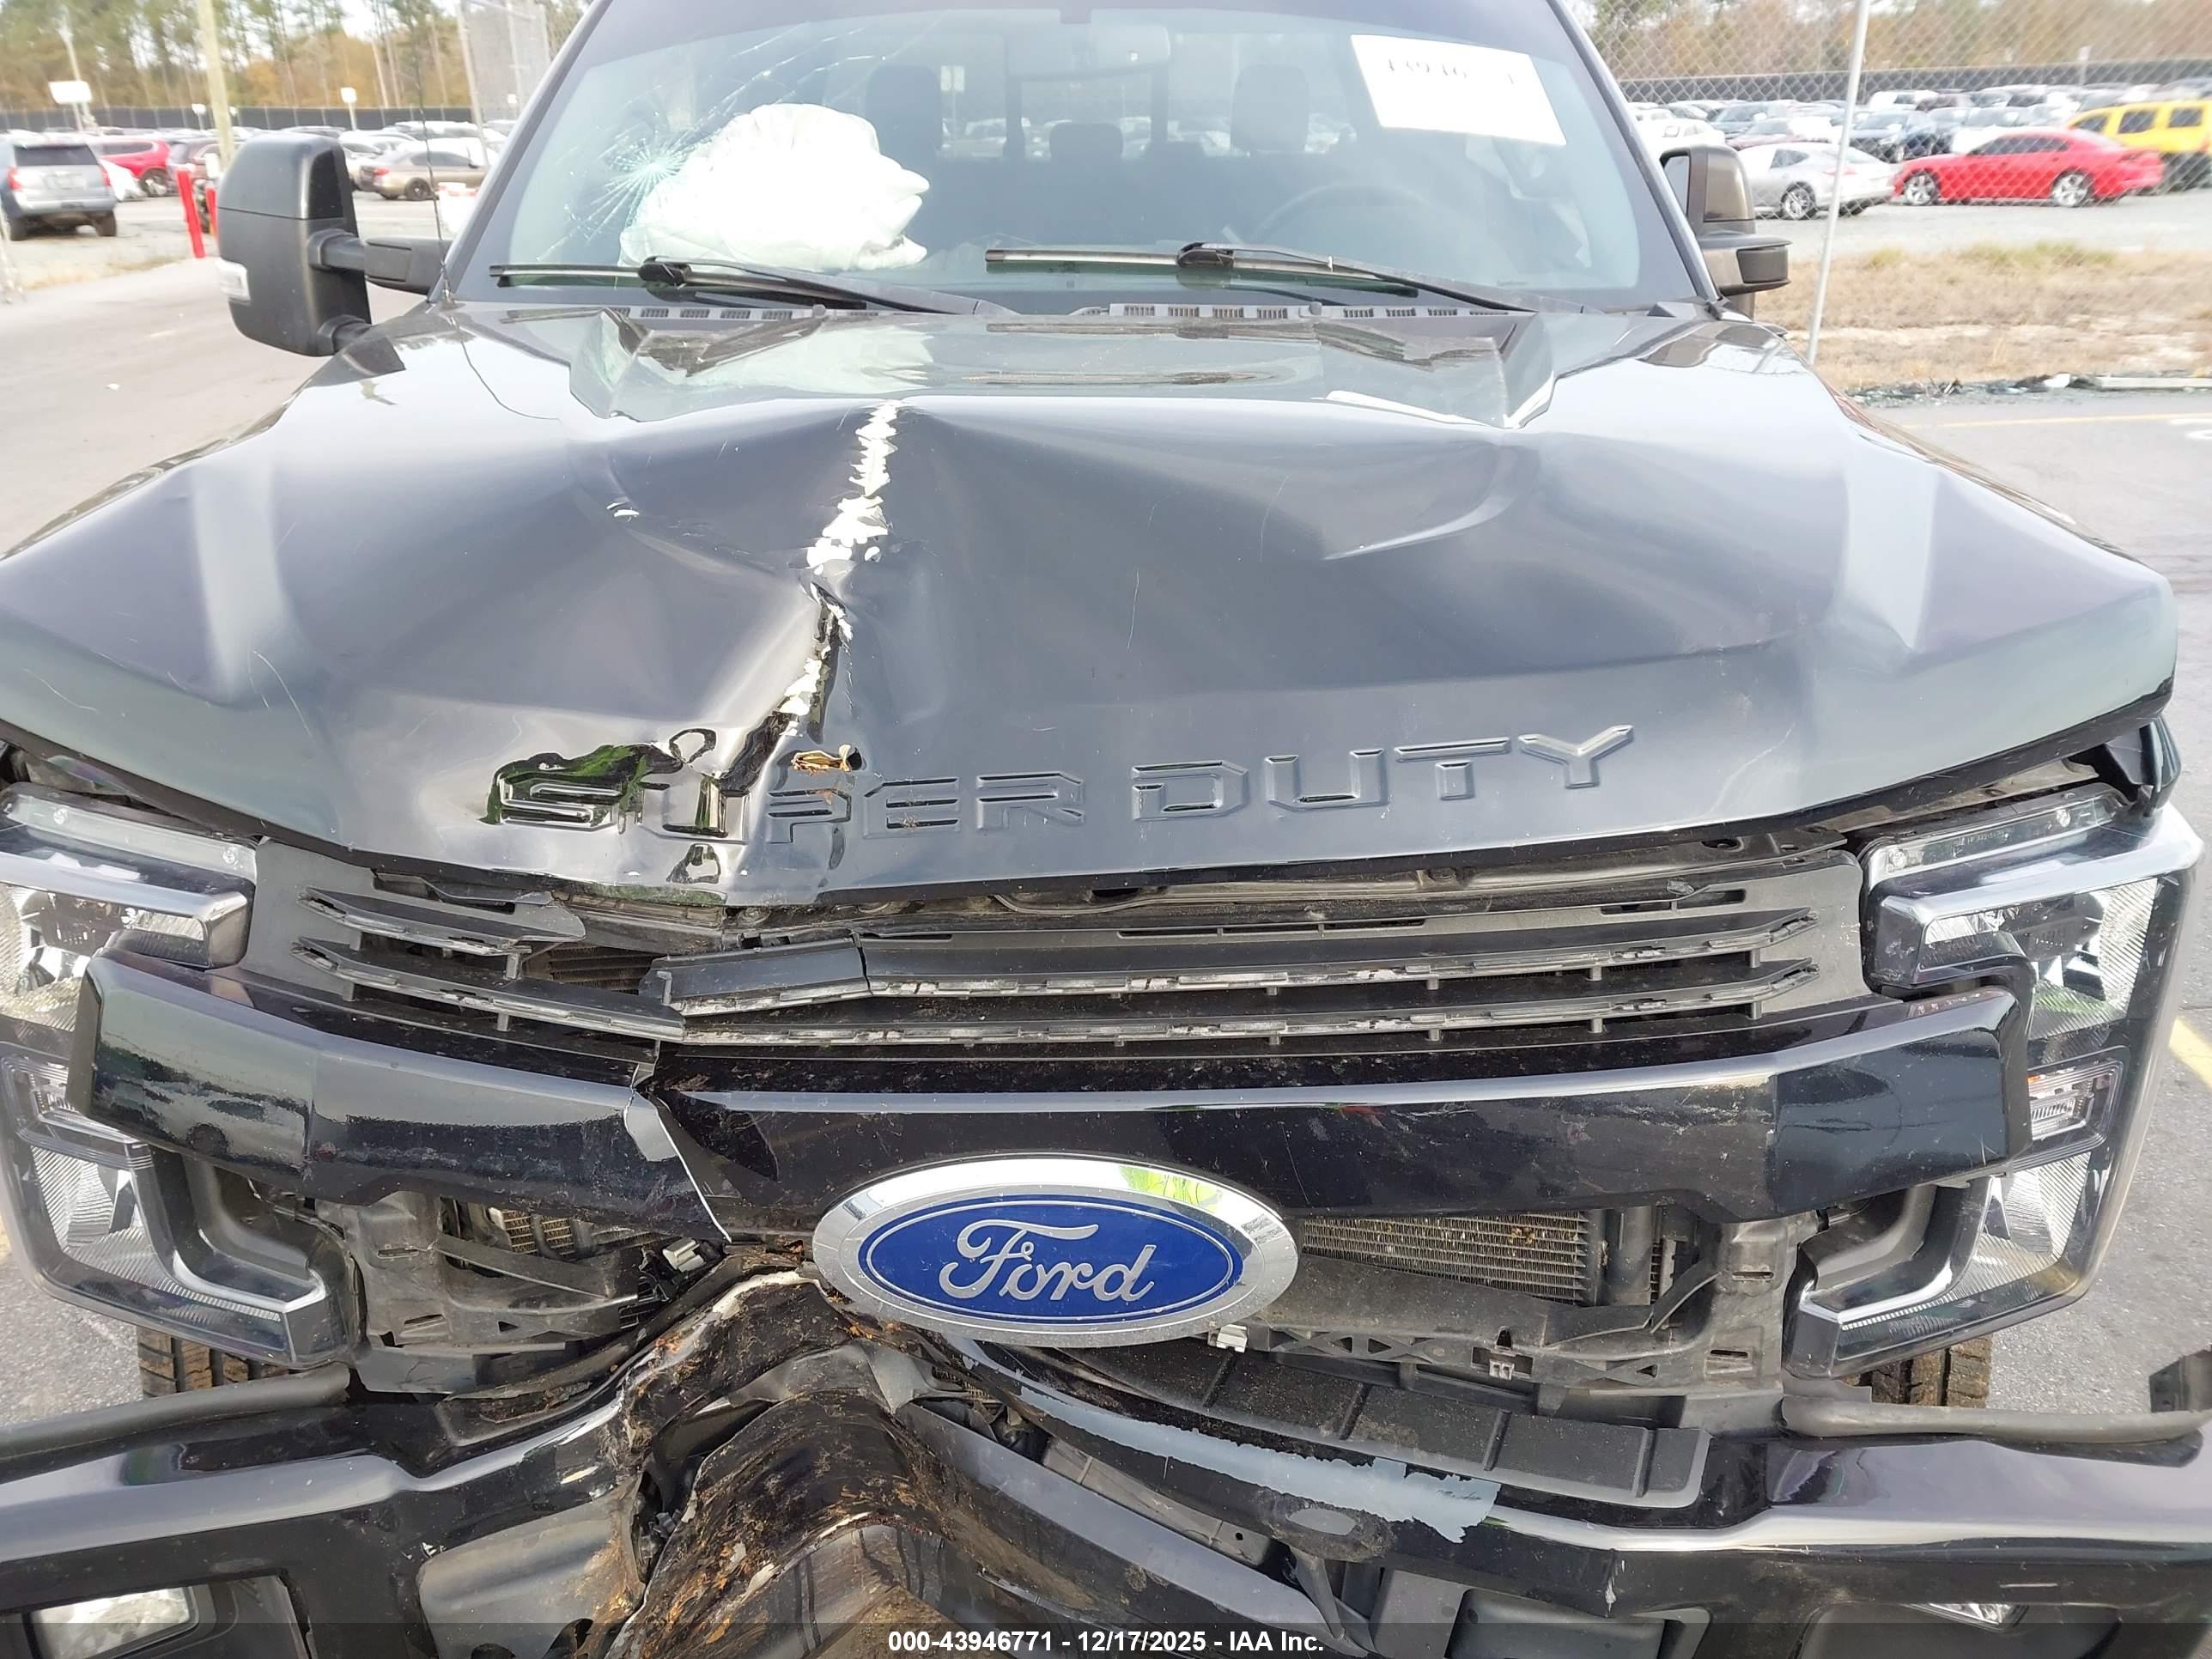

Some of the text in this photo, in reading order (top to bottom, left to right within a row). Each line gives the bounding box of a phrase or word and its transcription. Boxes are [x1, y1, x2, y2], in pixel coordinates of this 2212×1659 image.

[495, 724, 1634, 846] SUPER DUTY
[939, 1218, 1158, 1302] Ford
